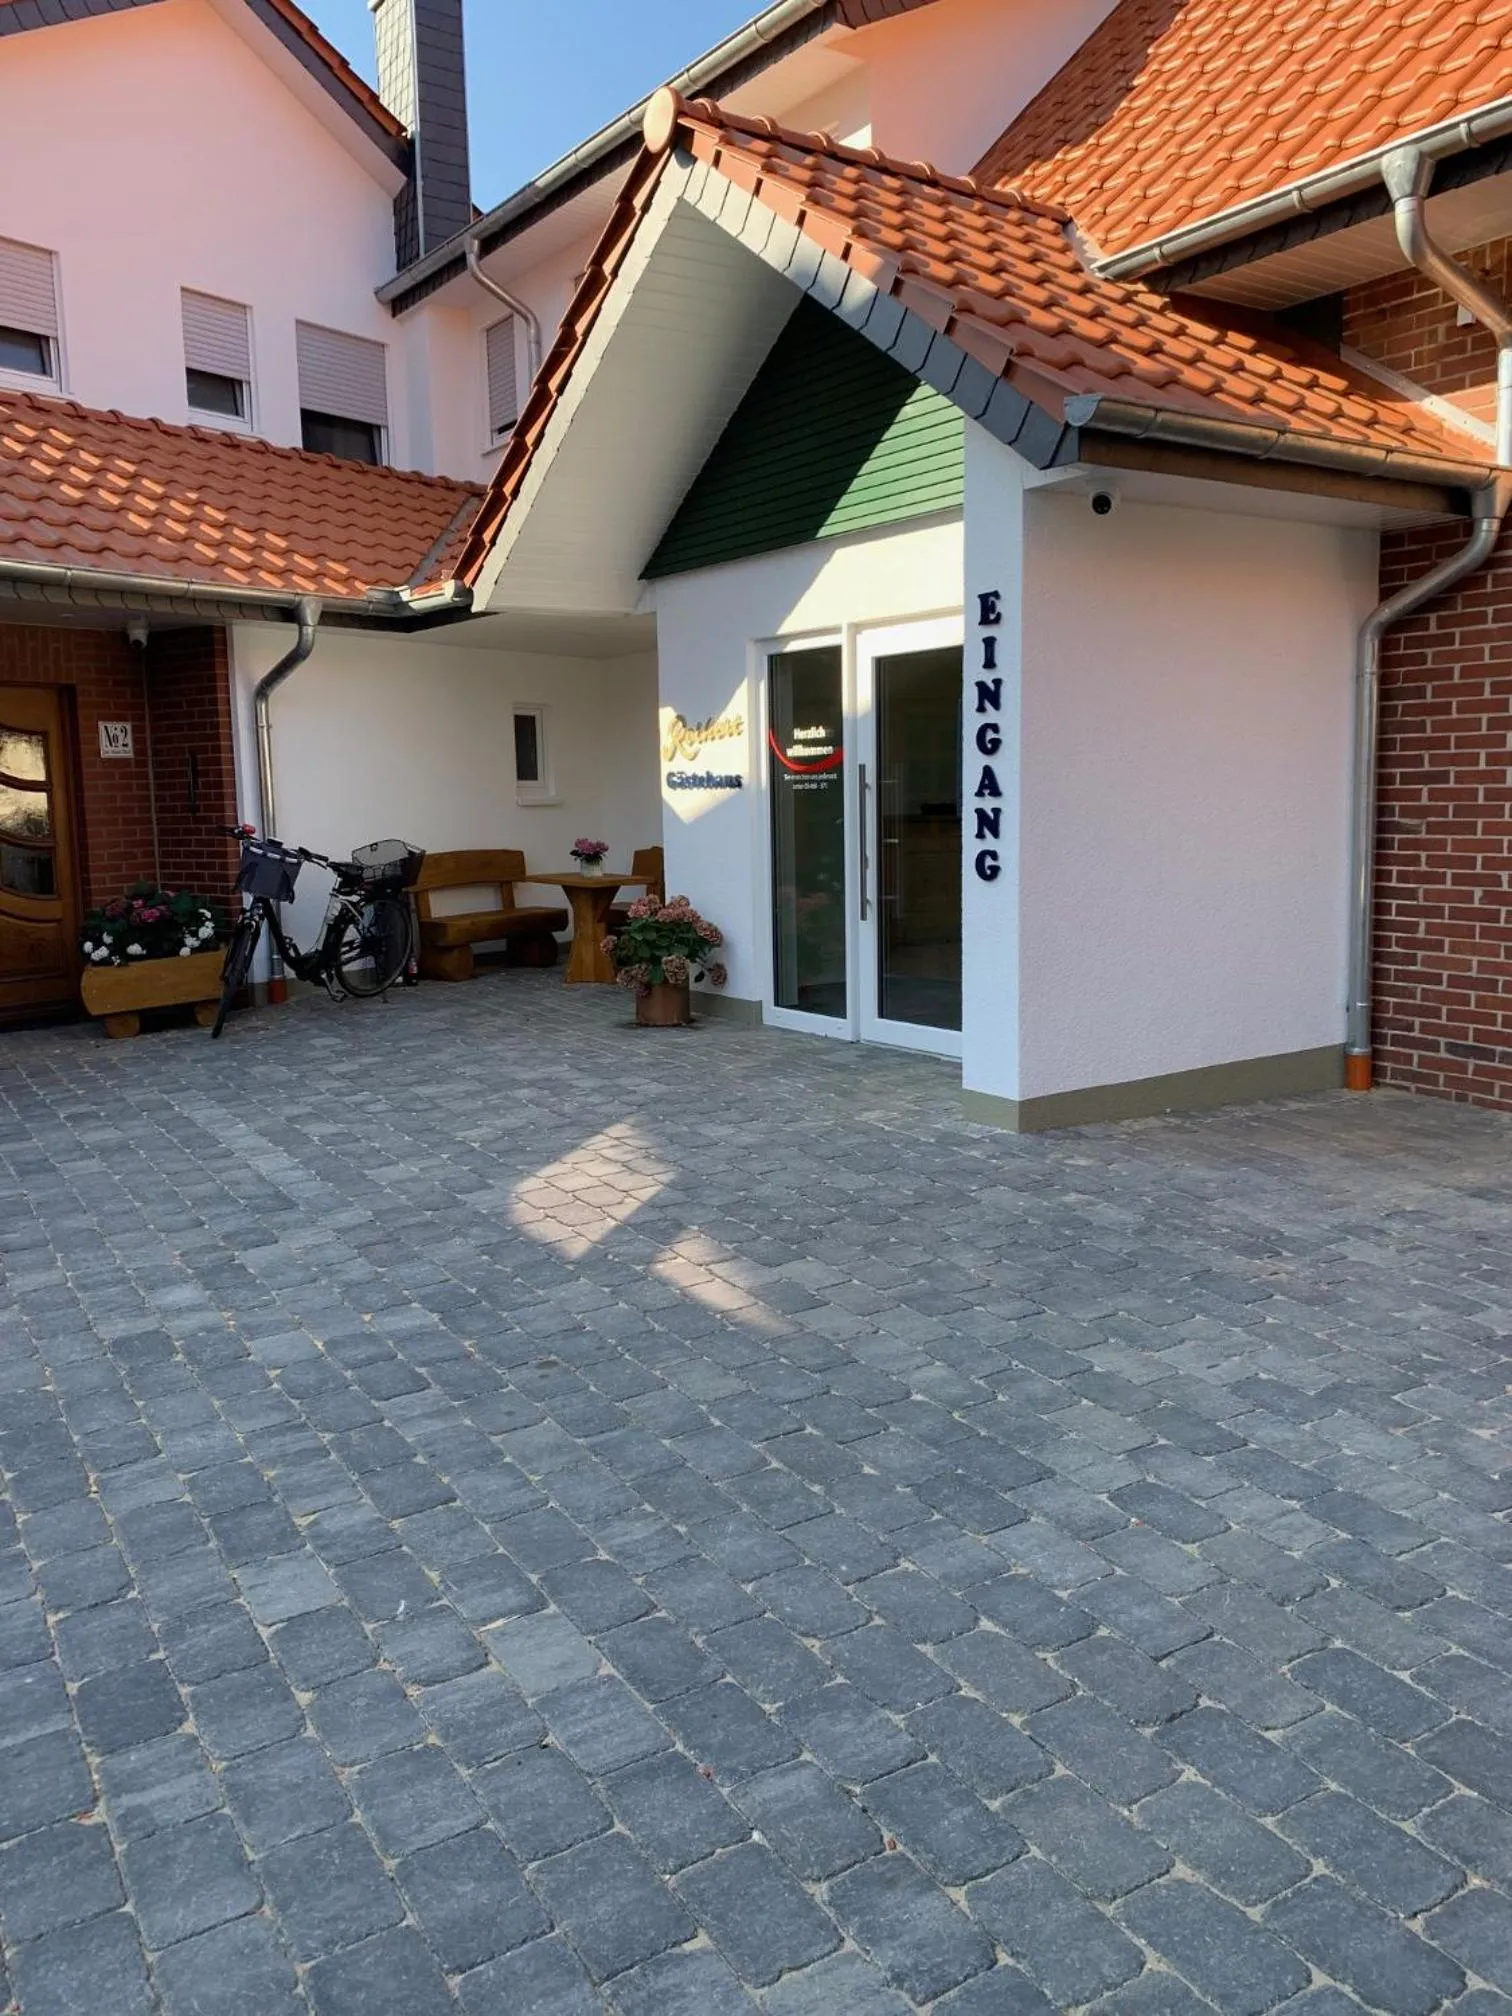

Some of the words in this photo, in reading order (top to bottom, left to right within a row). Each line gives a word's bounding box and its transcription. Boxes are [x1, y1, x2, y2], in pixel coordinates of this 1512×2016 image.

[793, 726, 826, 740] Herzlich
[975, 590, 1003, 882] EINGANG
[666, 771, 743, 790] Gästehaus
